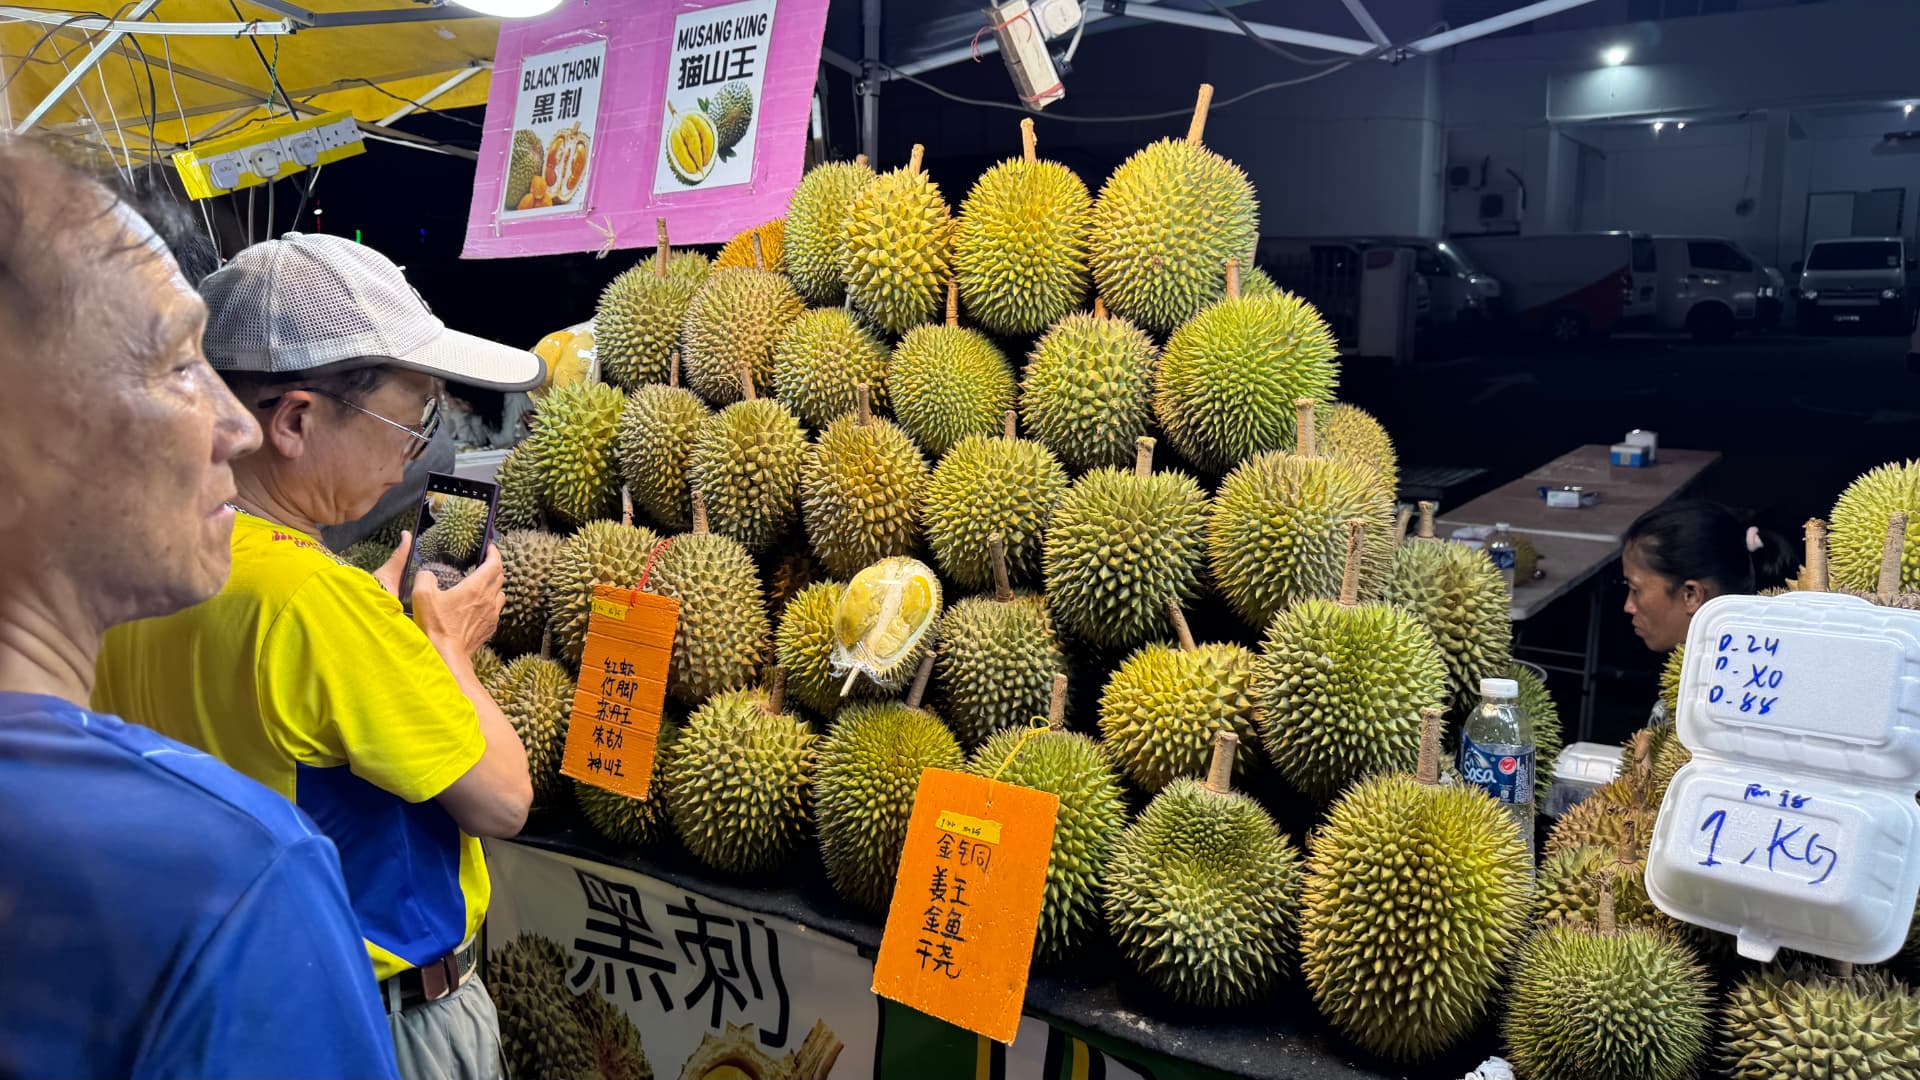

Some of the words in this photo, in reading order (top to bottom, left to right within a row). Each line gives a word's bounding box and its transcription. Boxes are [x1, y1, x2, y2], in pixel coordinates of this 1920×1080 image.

[677, 19, 732, 52] MUSANG
[734, 13, 768, 41] KING
[523, 64, 559, 91] BLACK
[561, 56, 601, 84] THORN
[678, 45, 757, 90] 猫山王
[531, 87, 583, 125] 黑刺
[603, 656, 636, 677] 红虾
[571, 866, 790, 1048] 黑刺
